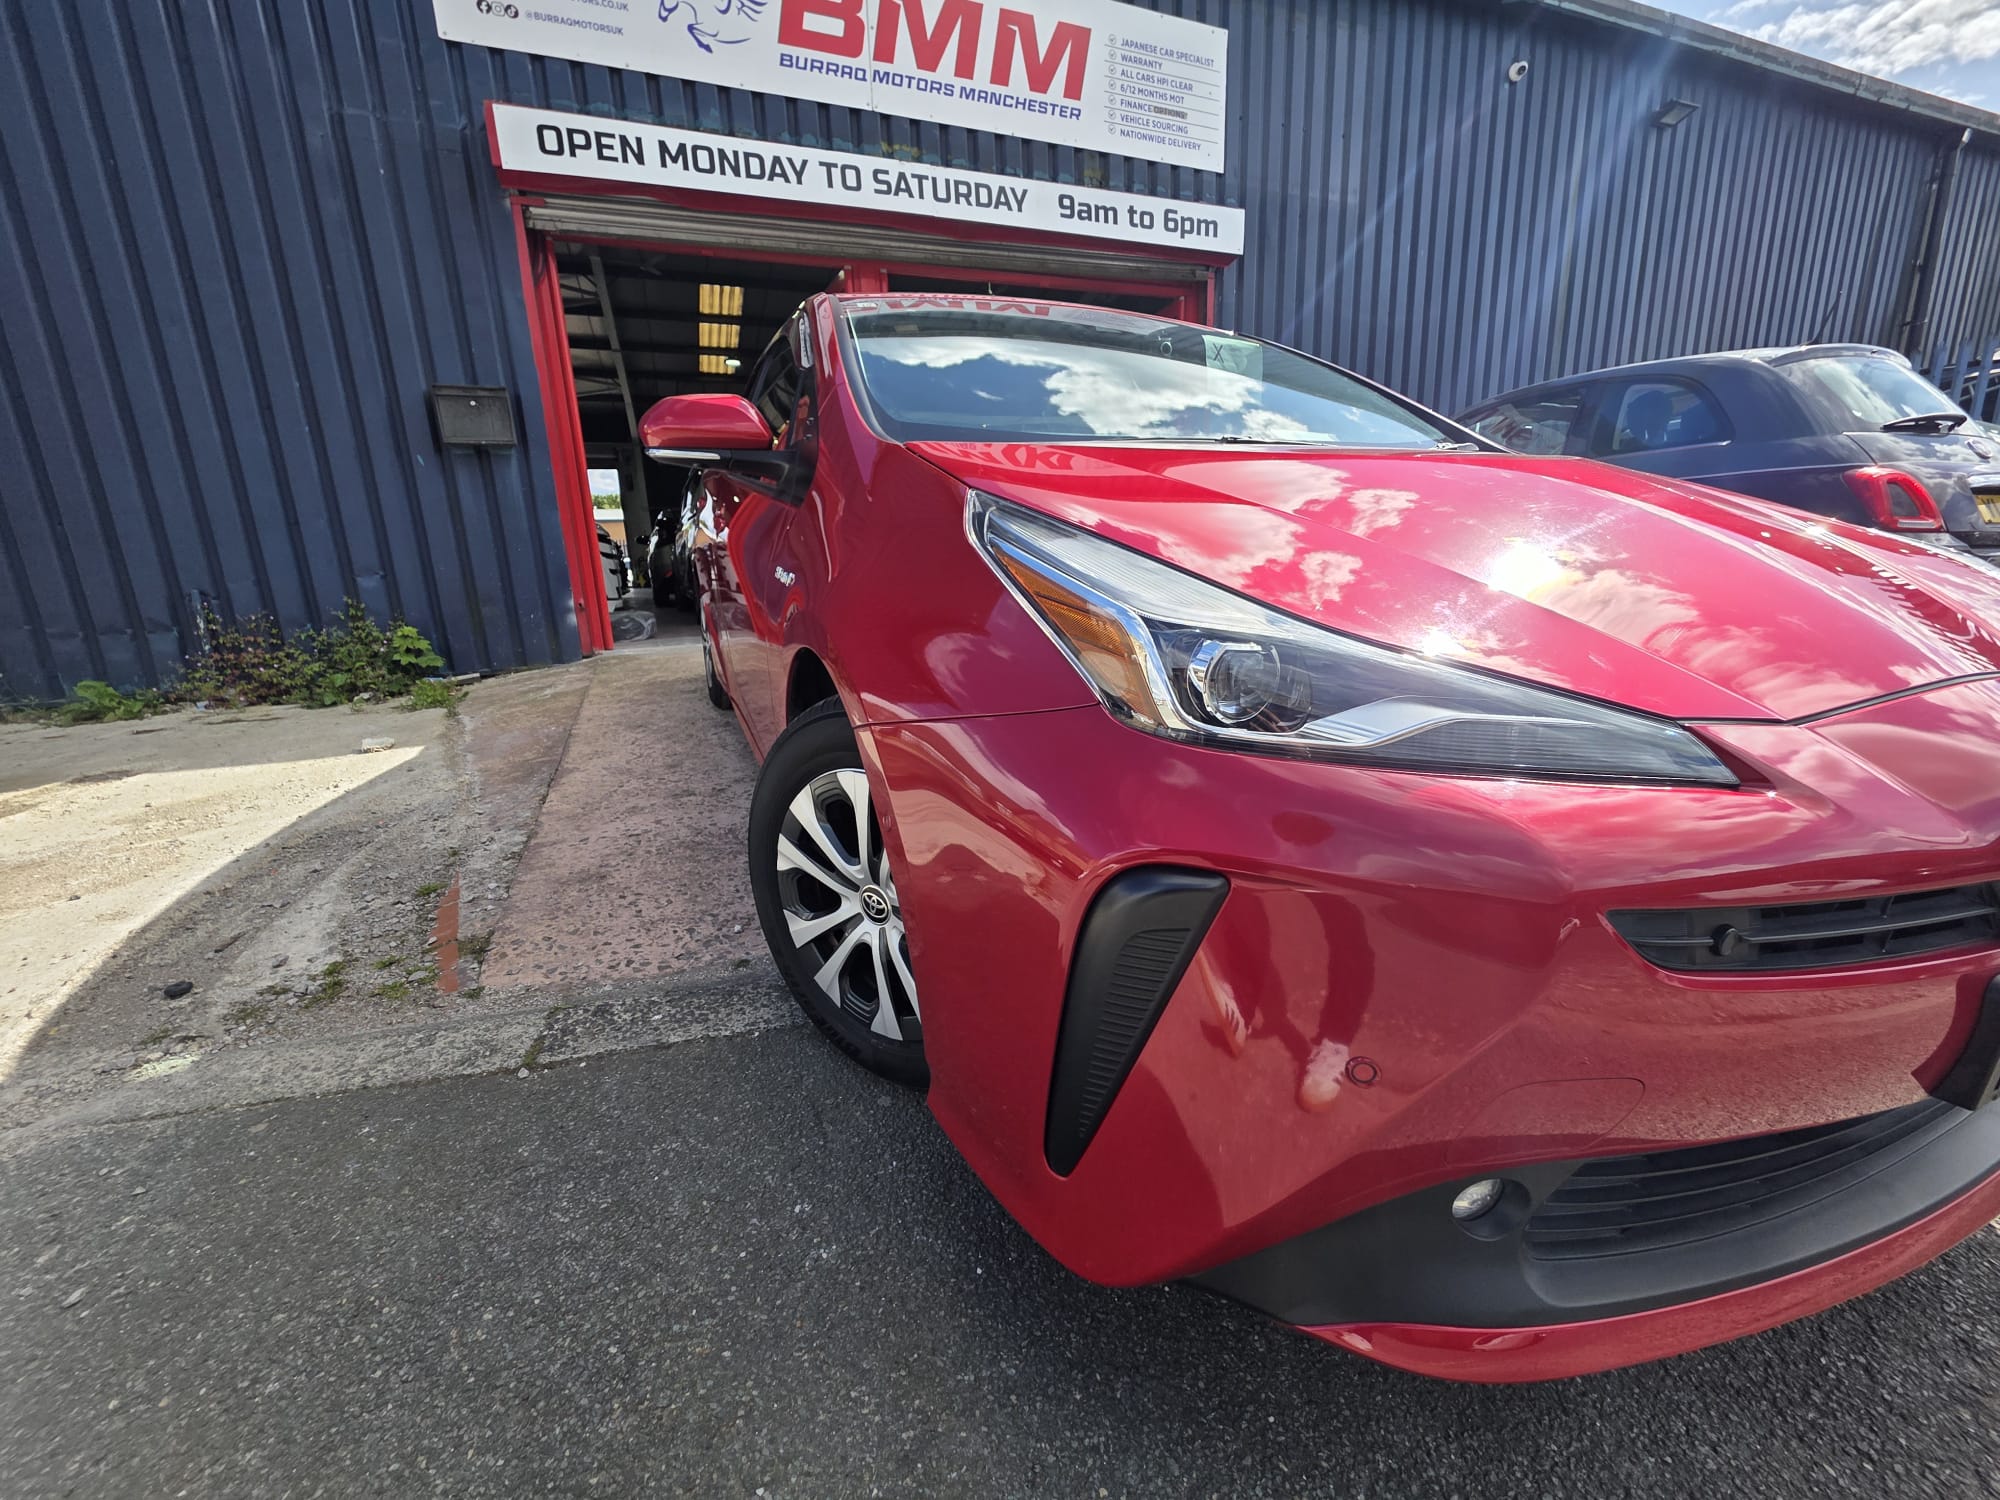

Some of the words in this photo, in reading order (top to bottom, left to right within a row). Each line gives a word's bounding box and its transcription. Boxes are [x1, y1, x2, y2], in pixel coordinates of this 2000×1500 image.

[778, 0, 1092, 101] BMM
[1120, 38, 1158, 54] JAPANESE
[1159, 47, 1175, 57] CAR
[1175, 51, 1214, 68] SPECIALIST
[1120, 53, 1163, 70] WARRANTY
[779, 53, 867, 82] BURRAQ
[872, 69, 955, 97] MOTORS
[959, 85, 1081, 120] MANCHESTER
[1120, 68, 1134, 79] ALL
[1136, 72, 1155, 84] CARS
[1156, 76, 1169, 86] HPI
[1170, 79, 1193, 91] CLEAR
[1120, 83, 1136, 95] 6/12
[1137, 87, 1168, 101] MONTHS
[1169, 96, 1185, 104] MOT
[1120, 98, 1153, 112] FINANCE
[1120, 113, 1150, 127] VEHICLE
[1152, 120, 1188, 134] SOURCING
[1120, 128, 1166, 145] NATIONWIDE
[1168, 137, 1201, 151] DELIVERY
[536, 124, 646, 165] OPEN
[658, 139, 808, 185] MONDAY
[818, 161, 862, 192] TO
[872, 168, 1028, 213] SATURDAY
[1058, 193, 1118, 225] 9am
[1127, 205, 1154, 230] to
[1163, 208, 1218, 239] 6pm
